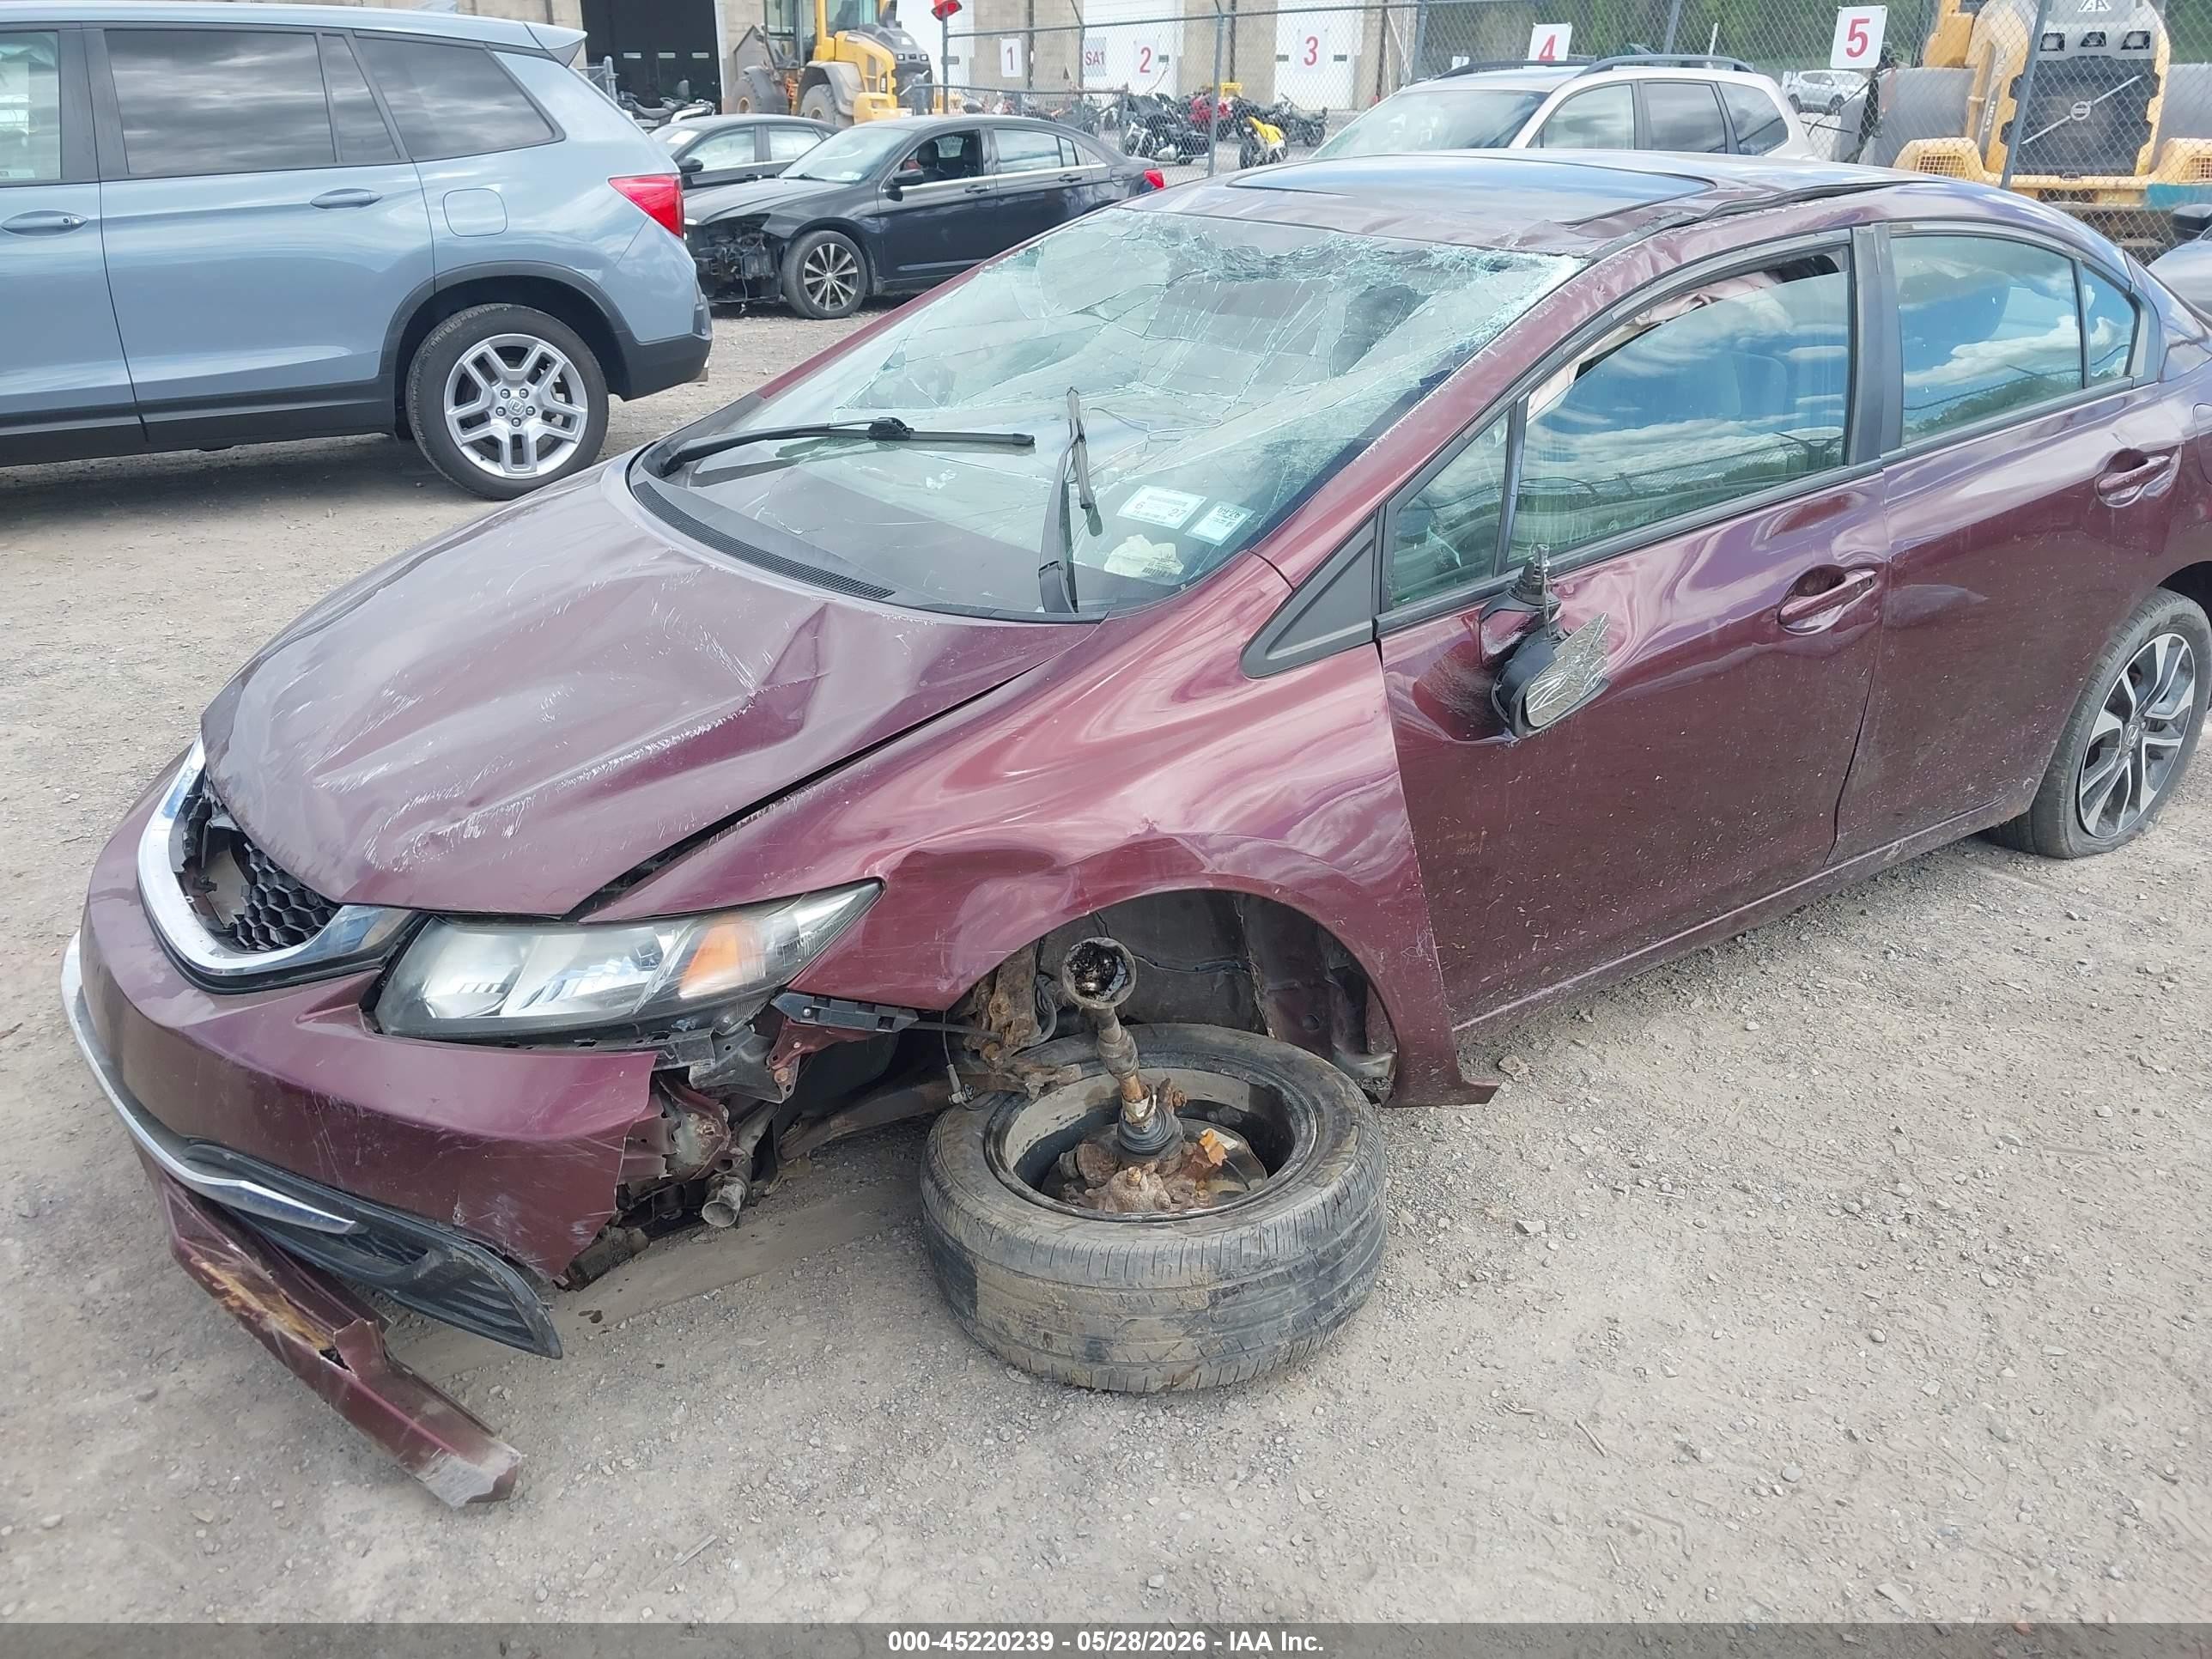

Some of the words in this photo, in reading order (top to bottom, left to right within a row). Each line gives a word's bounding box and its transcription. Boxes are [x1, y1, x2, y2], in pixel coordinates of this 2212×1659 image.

[1304, 35, 1320, 66] 3
[1538, 35, 1556, 62] 4
[1845, 17, 1870, 58] 5
[1006, 46, 1014, 70] 1
[1085, 51, 1106, 66] SA1
[1139, 46, 1152, 73] 2
[1168, 507, 1188, 518] 27
